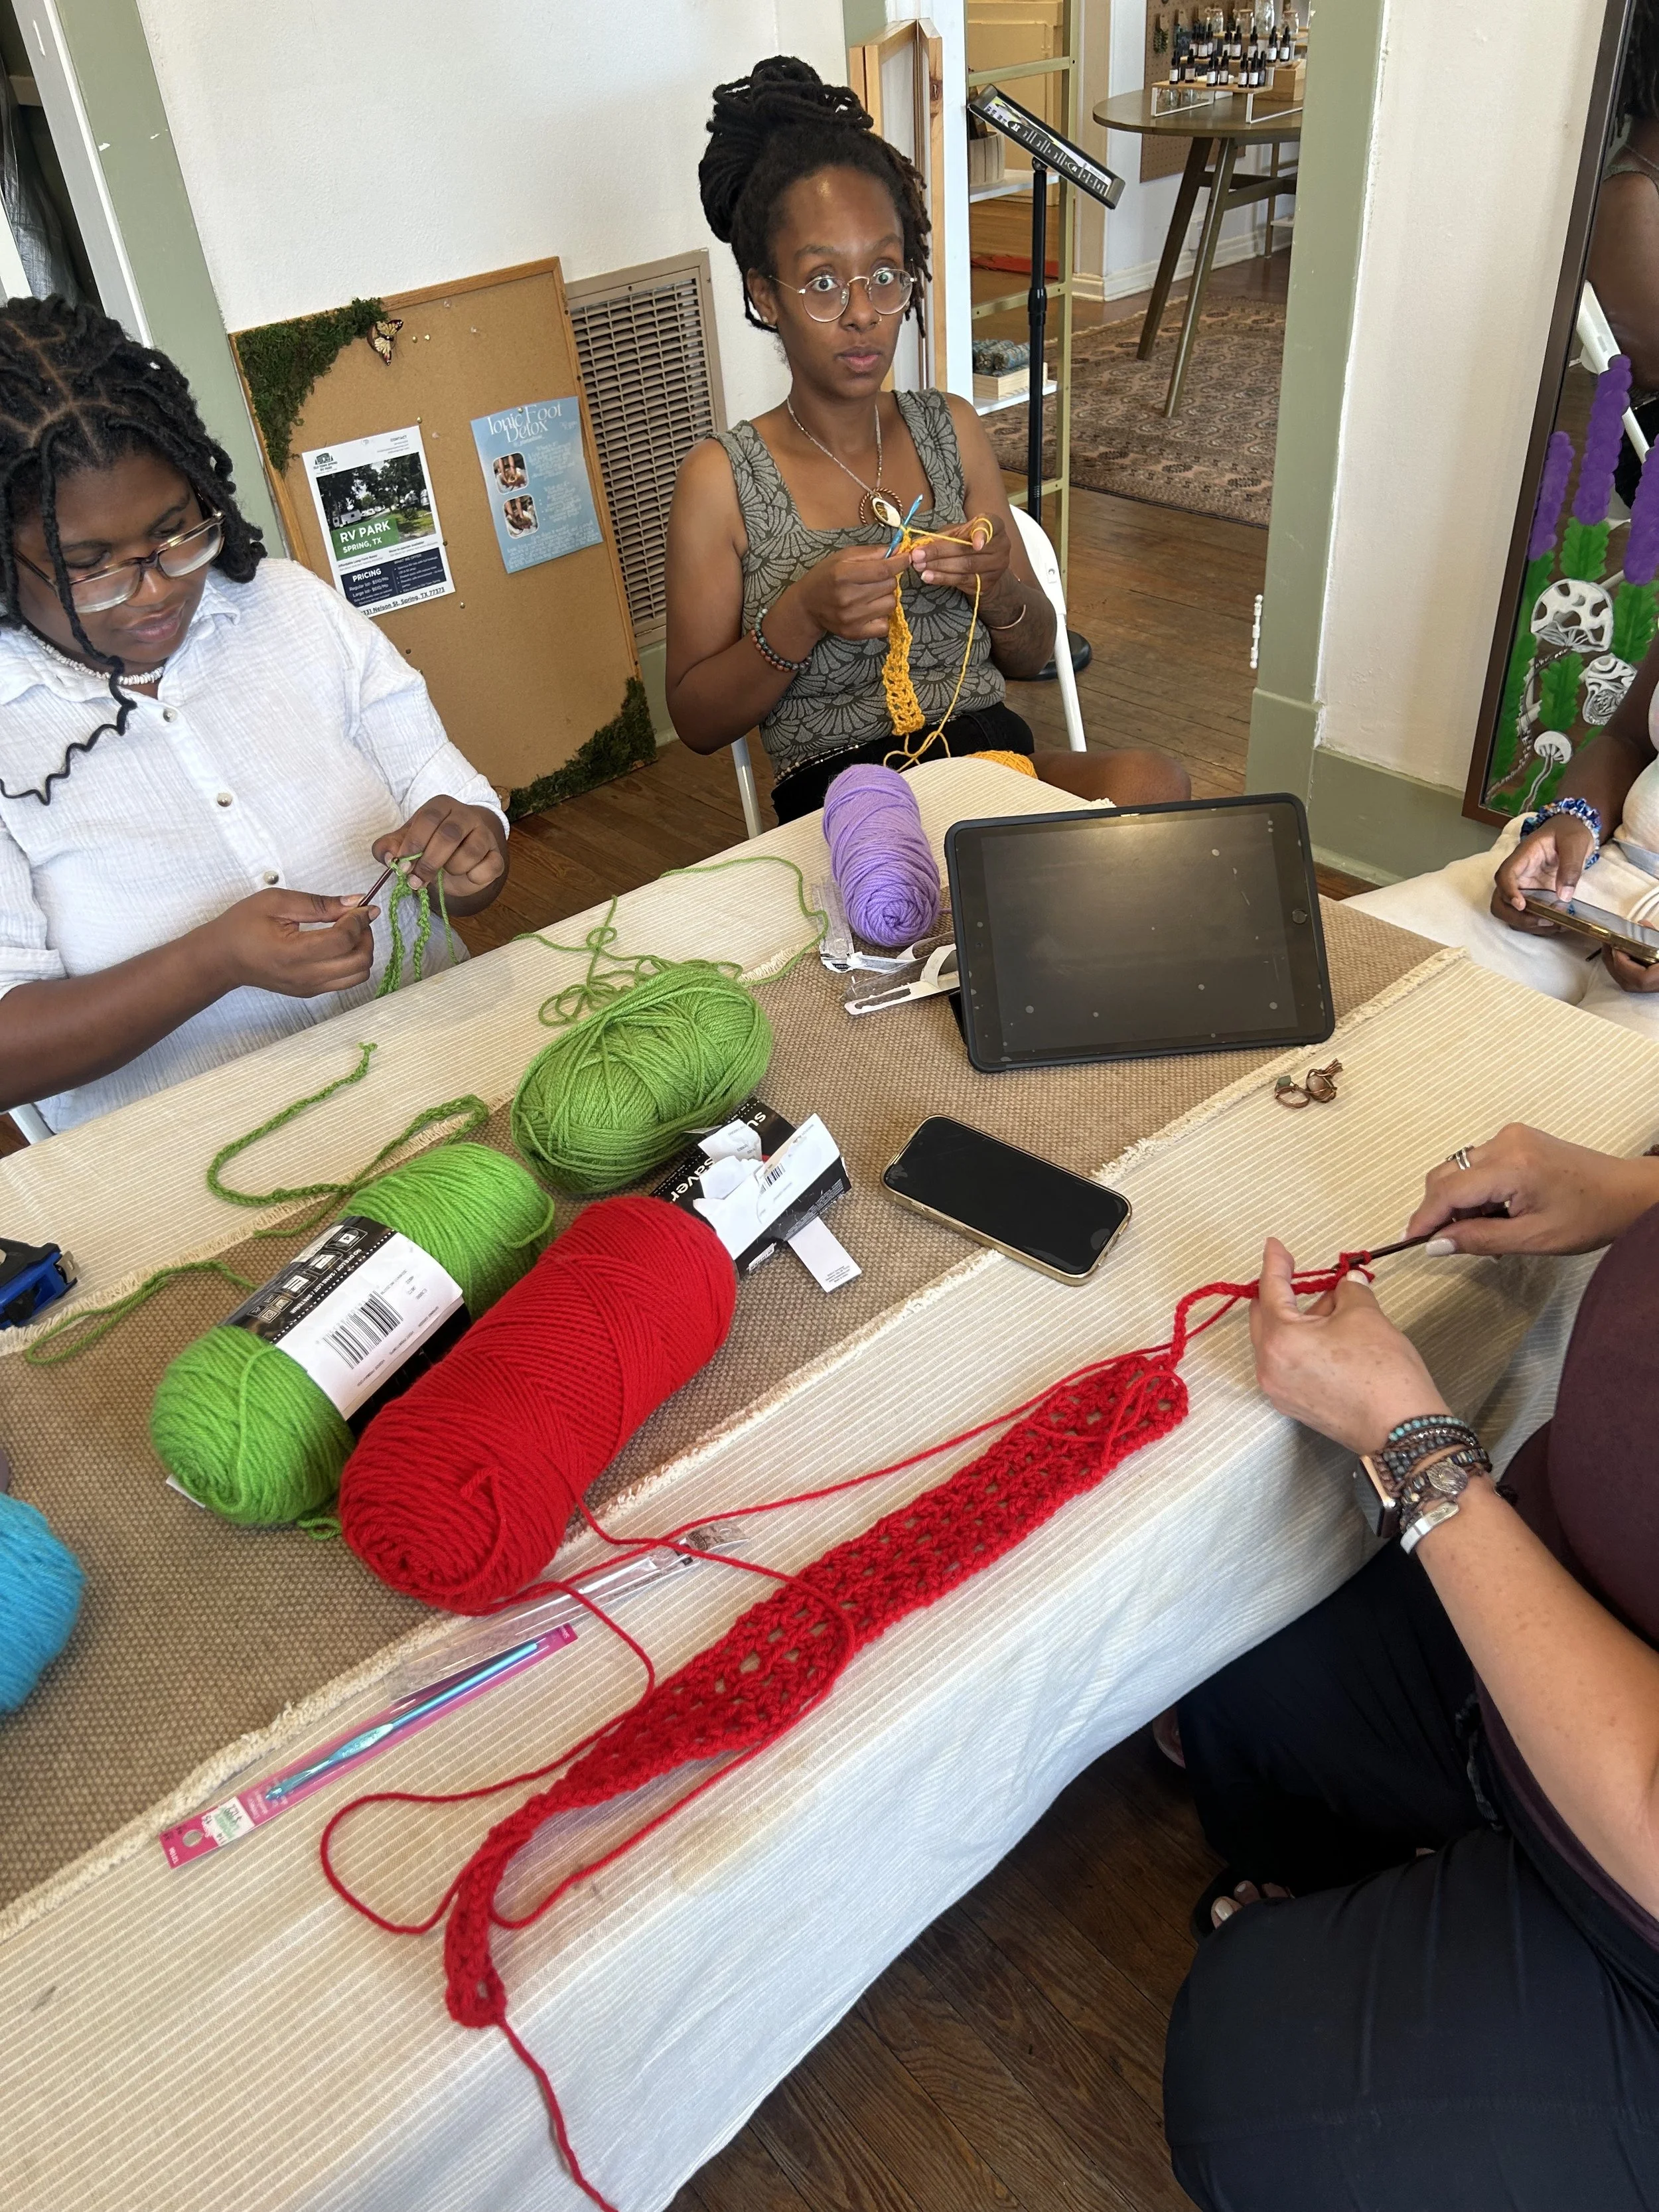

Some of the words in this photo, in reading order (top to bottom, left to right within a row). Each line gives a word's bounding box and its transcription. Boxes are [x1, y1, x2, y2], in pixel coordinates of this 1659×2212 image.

[487, 413, 524, 435] Ionic
[525, 403, 562, 424] Foot
[506, 419, 549, 443] Detox
[340, 528, 356, 543] RV
[359, 520, 391, 538] PARK
[343, 541, 372, 553] SPRING,
[352, 568, 382, 582] PRICING
[372, 602, 392, 612] Nelson
[670, 1157, 715, 1202] saver
[343, 1253, 355, 1264] DYE
[335, 1261, 346, 1272] LOT
[321, 1271, 336, 1284] SANS
[313, 1282, 323, 1292] LOT
